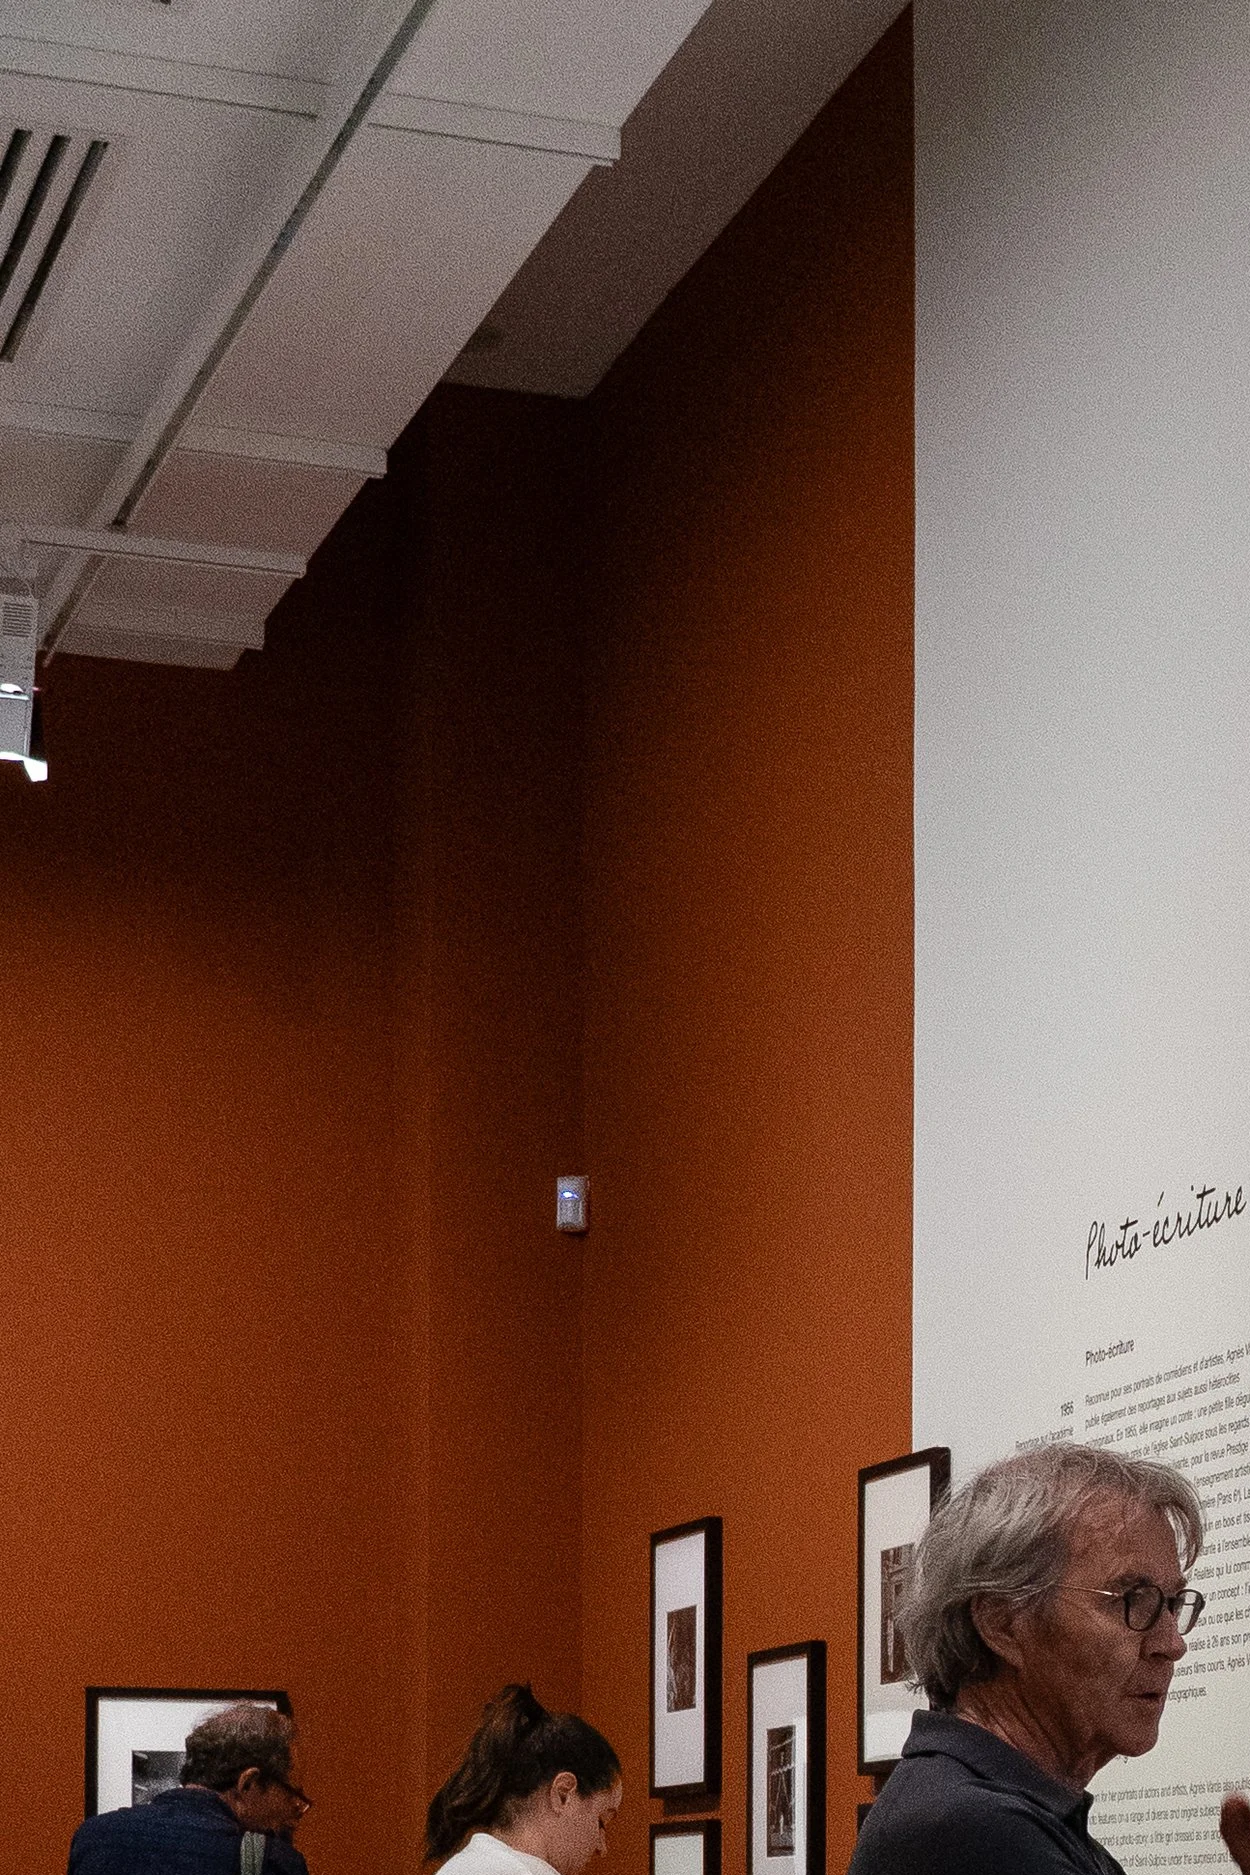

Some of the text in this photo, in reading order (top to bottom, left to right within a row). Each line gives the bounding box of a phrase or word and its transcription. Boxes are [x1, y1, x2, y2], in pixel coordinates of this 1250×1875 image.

[1085, 1184, 1247, 1280] Photo-écriture
[1085, 1339, 1134, 1366] Photo-écriture
[1110, 1386, 1122, 1400] pour
